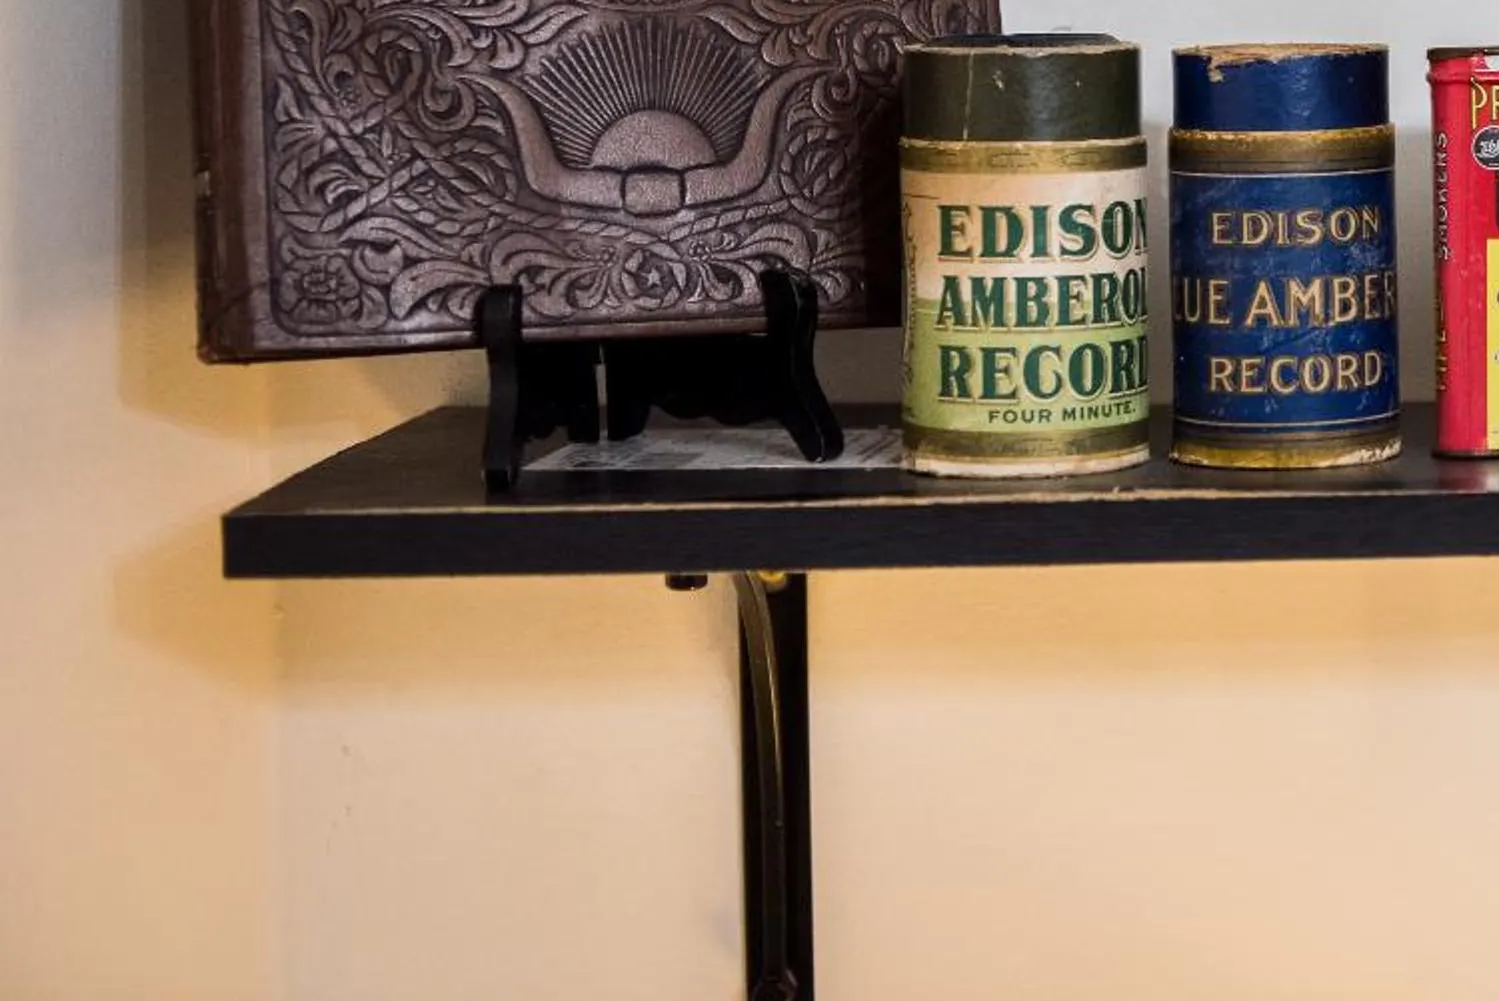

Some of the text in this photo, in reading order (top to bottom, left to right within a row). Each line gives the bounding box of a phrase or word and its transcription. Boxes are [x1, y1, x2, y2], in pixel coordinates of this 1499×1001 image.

[1211, 206, 1380, 245] EDISON
[1209, 352, 1382, 393] RECORD
[988, 401, 1136, 424] FOUR MINUTE.
